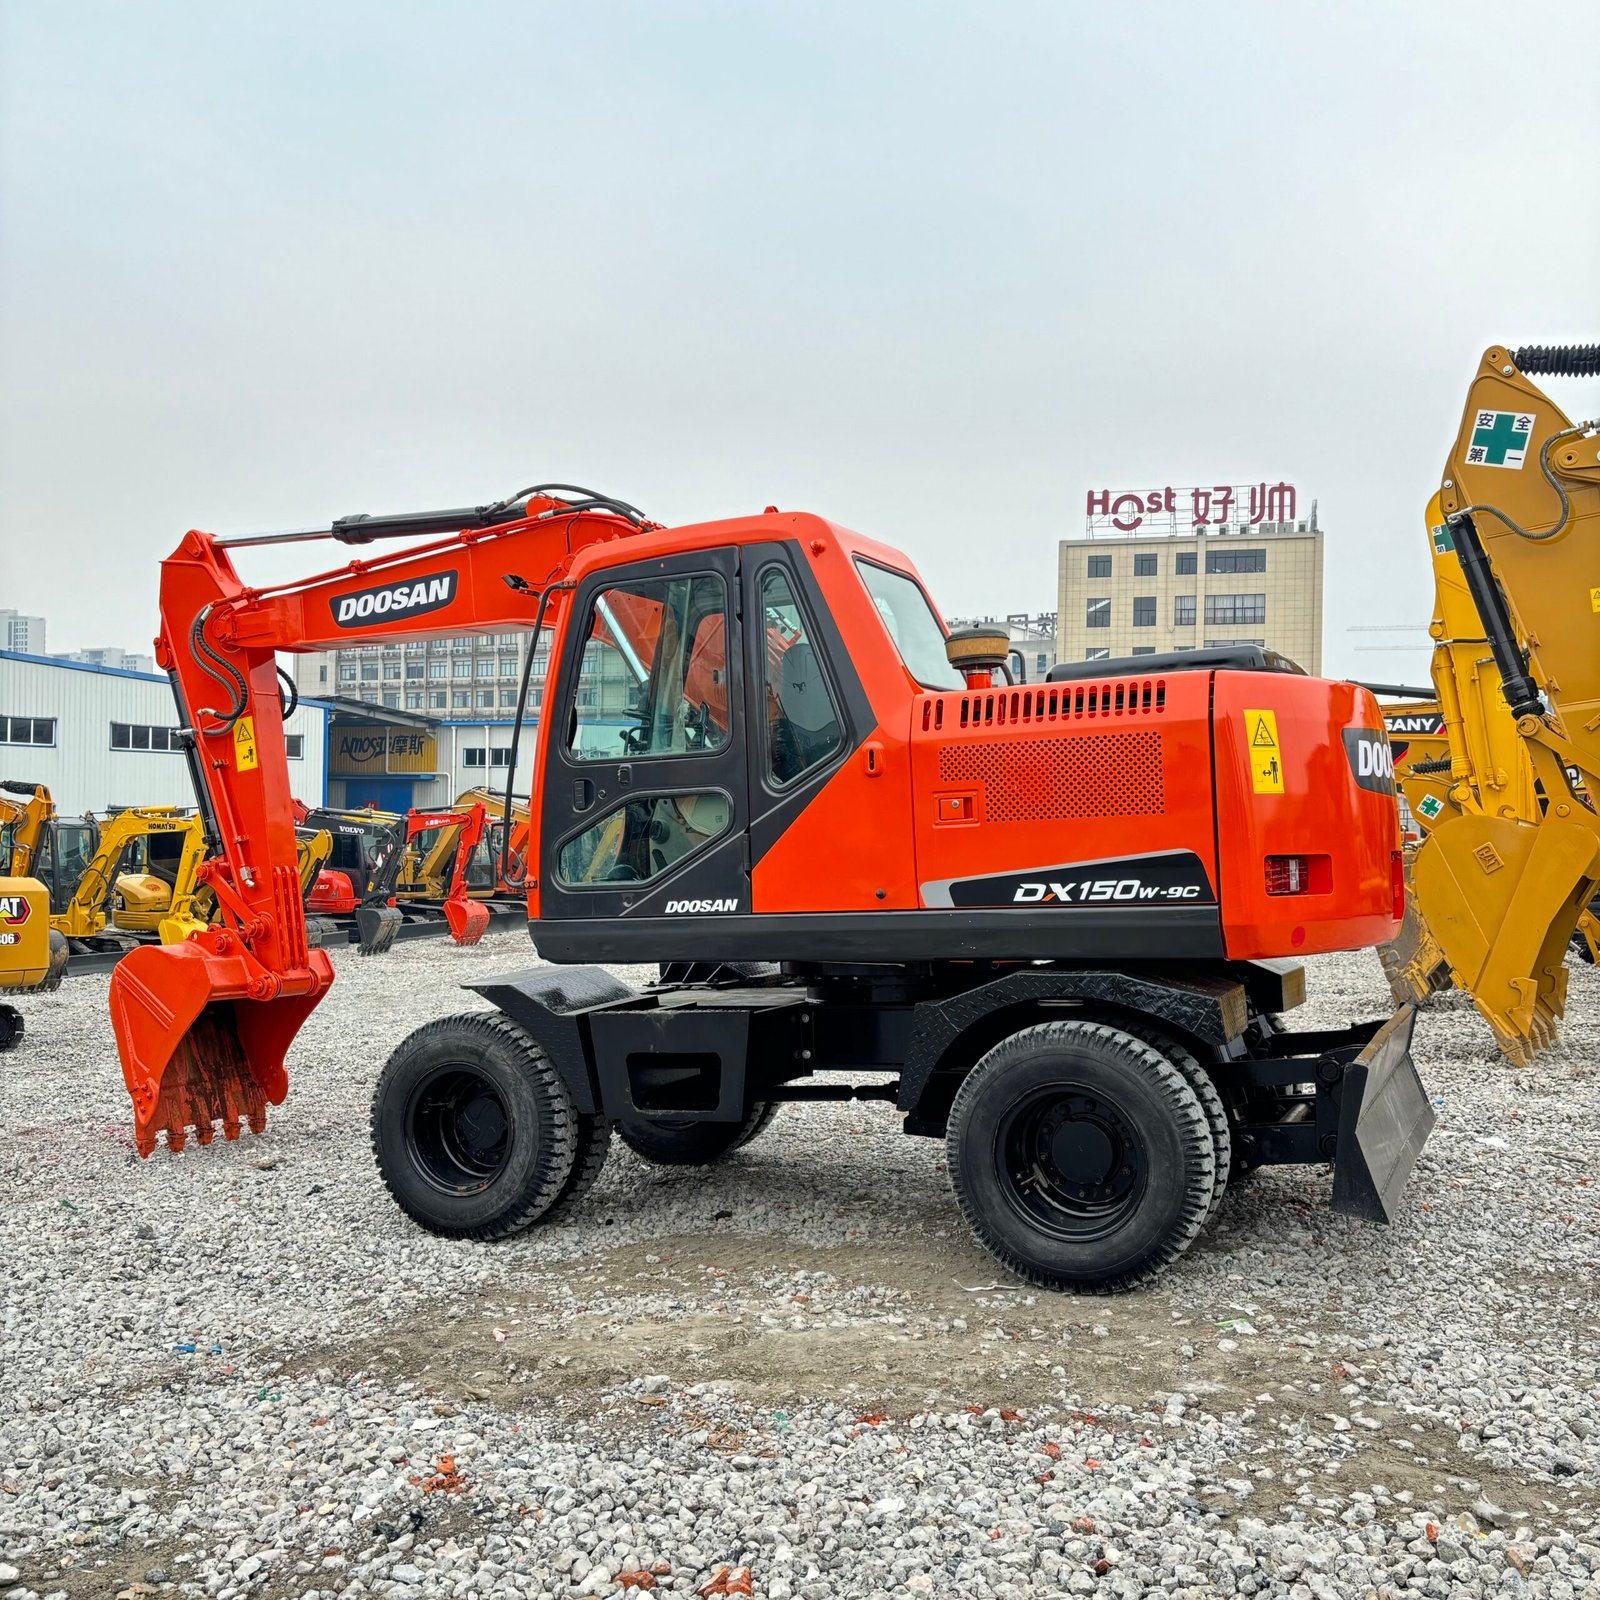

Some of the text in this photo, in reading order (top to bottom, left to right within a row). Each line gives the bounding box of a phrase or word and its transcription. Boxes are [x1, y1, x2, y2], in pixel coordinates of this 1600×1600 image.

[1087, 482, 1296, 531] Host 好帅
[338, 577, 451, 622] DOOSAN
[1358, 740, 1395, 779] DOO
[339, 825, 365, 834] VOLVO
[1476, 845, 1501, 870] CAT
[664, 898, 739, 913] DOOSAN
[0, 933, 15, 945] 06
